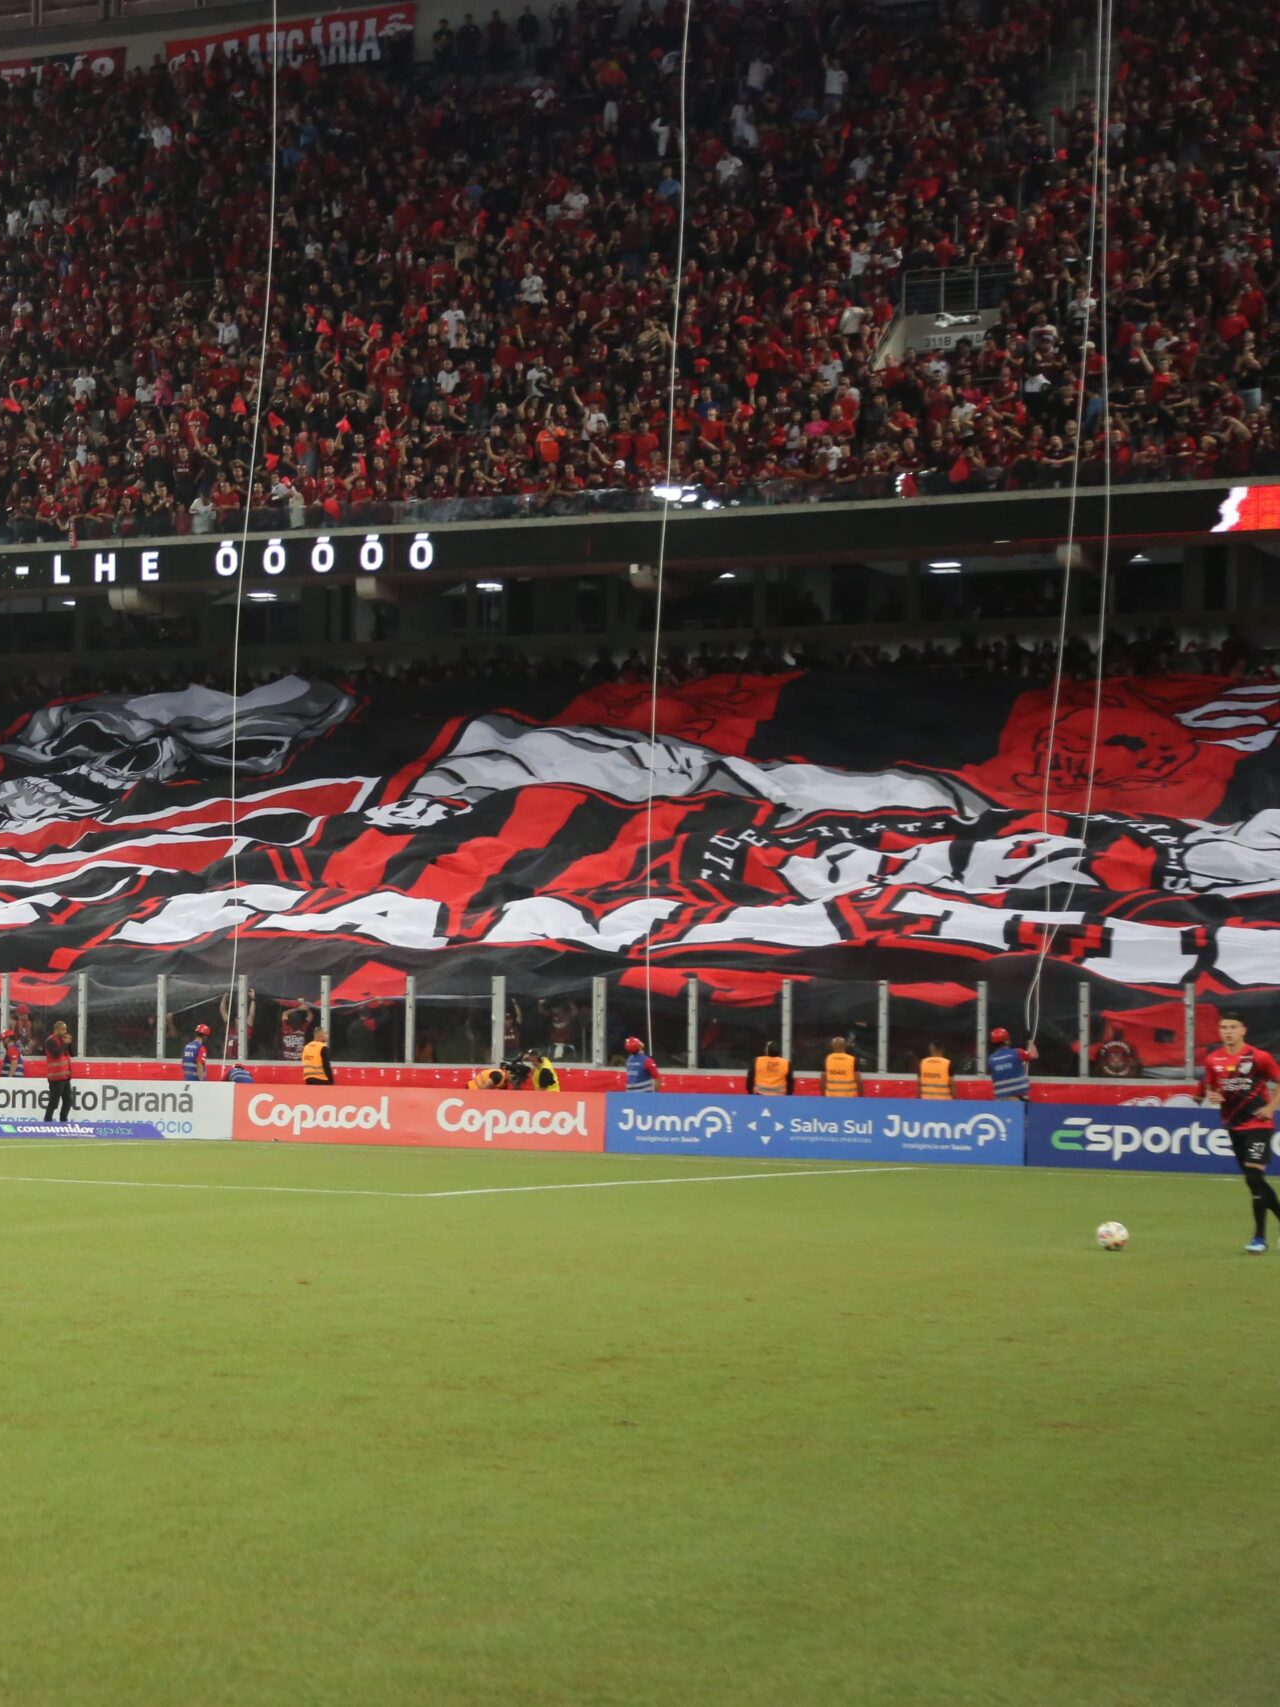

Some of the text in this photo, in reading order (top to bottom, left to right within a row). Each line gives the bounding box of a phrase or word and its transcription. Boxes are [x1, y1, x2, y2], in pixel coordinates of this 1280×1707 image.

[205, 18, 382, 72] AUCÁRIA
[247, 1093, 391, 1136] Copacol
[436, 1098, 588, 1141] Copacol
[790, 1118, 873, 1134] Salva Sul
